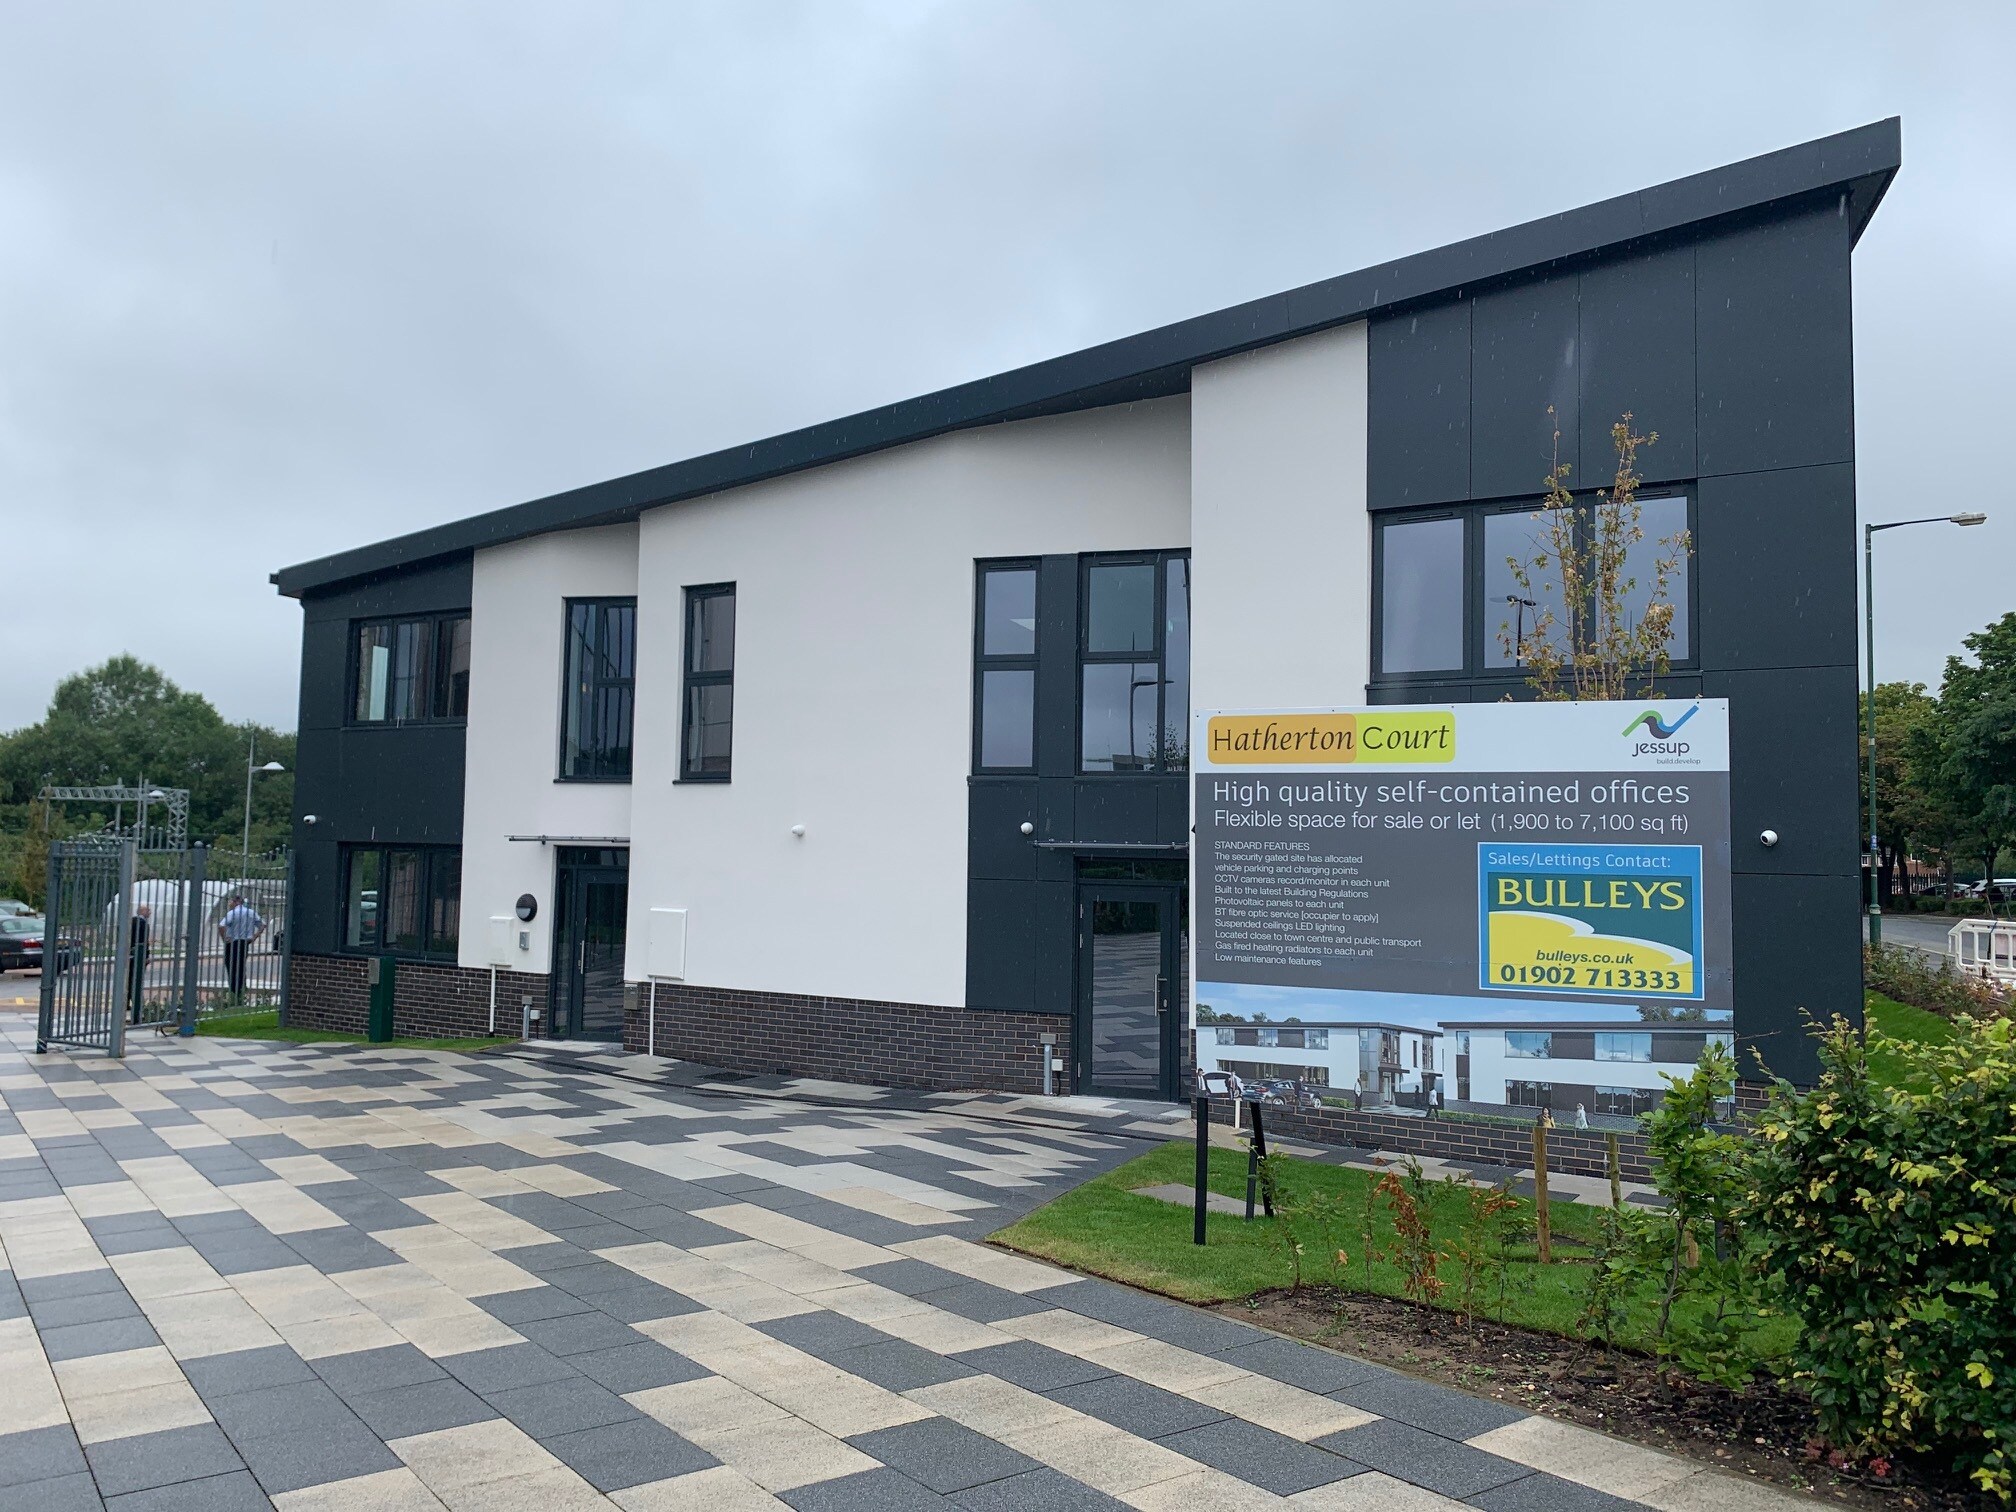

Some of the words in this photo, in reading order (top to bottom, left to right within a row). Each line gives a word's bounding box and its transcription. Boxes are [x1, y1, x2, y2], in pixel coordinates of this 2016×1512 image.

[1214, 723, 1354, 751] Hatherton
[1363, 725, 1450, 749] Court
[1214, 781, 1270, 807] High
[1279, 780, 1368, 807] quality
[1377, 780, 1579, 803] self-contained
[1591, 779, 1690, 803] offices
[1214, 810, 1282, 827] Flexible
[1288, 814, 1346, 831] space
[1351, 811, 1378, 829] for
[1384, 811, 1423, 829] sale
[1430, 815, 1451, 830] or
[1457, 812, 1481, 830] let
[1491, 813, 1549, 832] (1,900
[1555, 814, 1574, 830] to
[1580, 814, 1634, 832] 7,100
[1640, 817, 1664, 834] sq
[1670, 814, 1689, 834] ft)
[1214, 841, 1262, 850] STANDARD
[1264, 842, 1310, 851] FEATURES
[1215, 852, 1230, 860] The
[1232, 853, 1263, 862] security
[1265, 854, 1288, 863] gated
[1290, 854, 1305, 862] site
[1307, 854, 1322, 863] has
[1324, 855, 1363, 863] allocated
[1488, 852, 1600, 869] Sales/Lettings
[1605, 854, 1671, 868] Contact:
[1244, 864, 1274, 874] parking
[1276, 865, 1291, 873] and
[1294, 865, 1330, 876] charging
[1332, 866, 1359, 875] points
[1214, 874, 1238, 882] CCTV
[1240, 876, 1275, 884] cameras
[1277, 877, 1339, 886] record/monitor
[1341, 878, 1348, 886] in
[1350, 878, 1371, 887] each
[1374, 879, 1390, 887] unit
[1215, 885, 1232, 894] Built
[1234, 886, 1243, 894] to
[1245, 886, 1258, 894] the
[1260, 887, 1281, 895] latest
[1284, 887, 1317, 898] Building
[1319, 888, 1369, 899] Regulations
[1497, 878, 1685, 910] BULLEYS
[1215, 896, 1264, 906] Photovoltaic
[1266, 899, 1293, 907] panels
[1295, 899, 1303, 907] to
[1306, 900, 1326, 908] each
[1328, 901, 1344, 909] unit
[1215, 908, 1226, 916] BT
[1228, 908, 1246, 916] fibre
[1248, 910, 1268, 918] optic
[1270, 910, 1299, 919] service
[1342, 912, 1351, 921] to
[1215, 918, 1261, 929] Suspended
[1262, 921, 1293, 931] ceilings
[1295, 922, 1313, 930] LED
[1315, 923, 1345, 934] lighting
[1215, 930, 1248, 939] Located
[1250, 932, 1272, 940] close
[1273, 933, 1282, 941] to
[1284, 933, 1304, 941] town
[1307, 935, 1333, 943] centre
[1335, 936, 1351, 944] and
[1354, 936, 1380, 946] public
[1382, 937, 1422, 947] transport
[1215, 941, 1231, 950] Gas
[1234, 942, 1251, 950] fired
[1253, 943, 1283, 954] heating
[1285, 945, 1321, 954] radiators
[1324, 947, 1332, 955] to
[1334, 947, 1355, 956] each
[1357, 948, 1373, 956] unit
[1215, 953, 1232, 962] Low
[1234, 955, 1286, 964] maintenance
[1288, 957, 1321, 966] features
[1536, 950, 1634, 964] bulleys.co.uk
[1500, 964, 1576, 985] 01902
[1586, 968, 1680, 989] 713333
